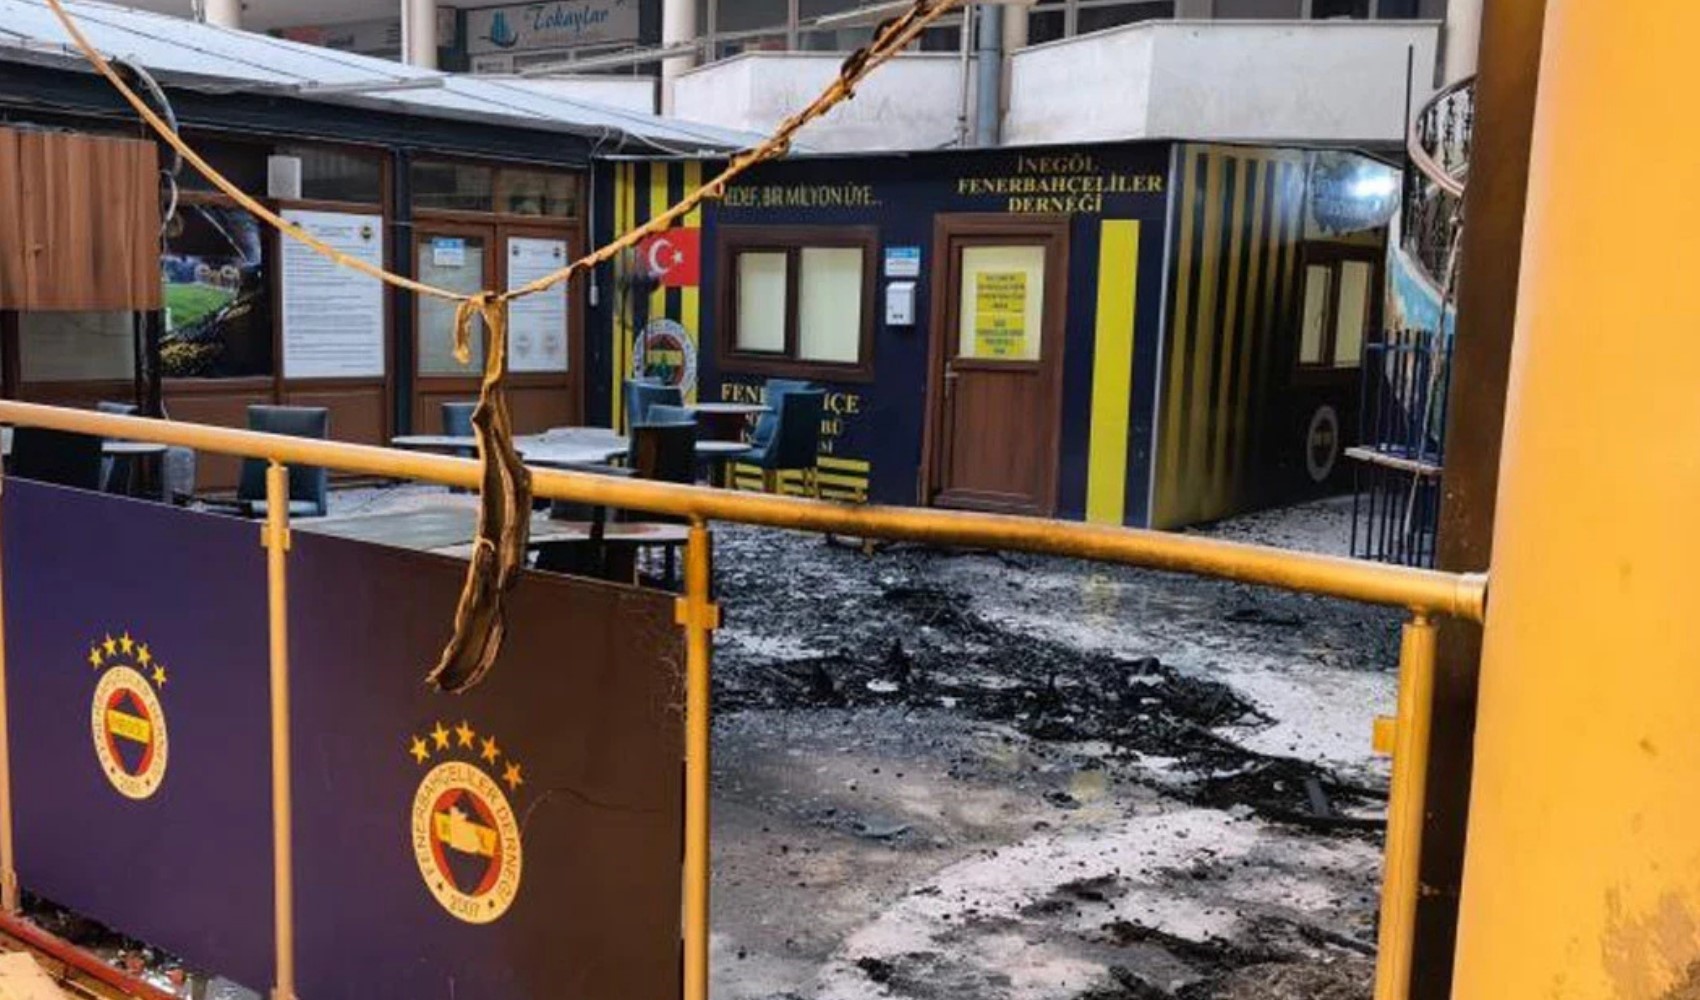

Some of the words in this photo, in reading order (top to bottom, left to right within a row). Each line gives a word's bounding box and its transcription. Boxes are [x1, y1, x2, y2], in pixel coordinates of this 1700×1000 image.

[1018, 153, 1098, 173] İNEGÖL
[958, 173, 1164, 194] FENERBAHÇELİLER
[718, 184, 761, 208] EDEF,
[1009, 194, 1103, 213] DERNEĞİ
